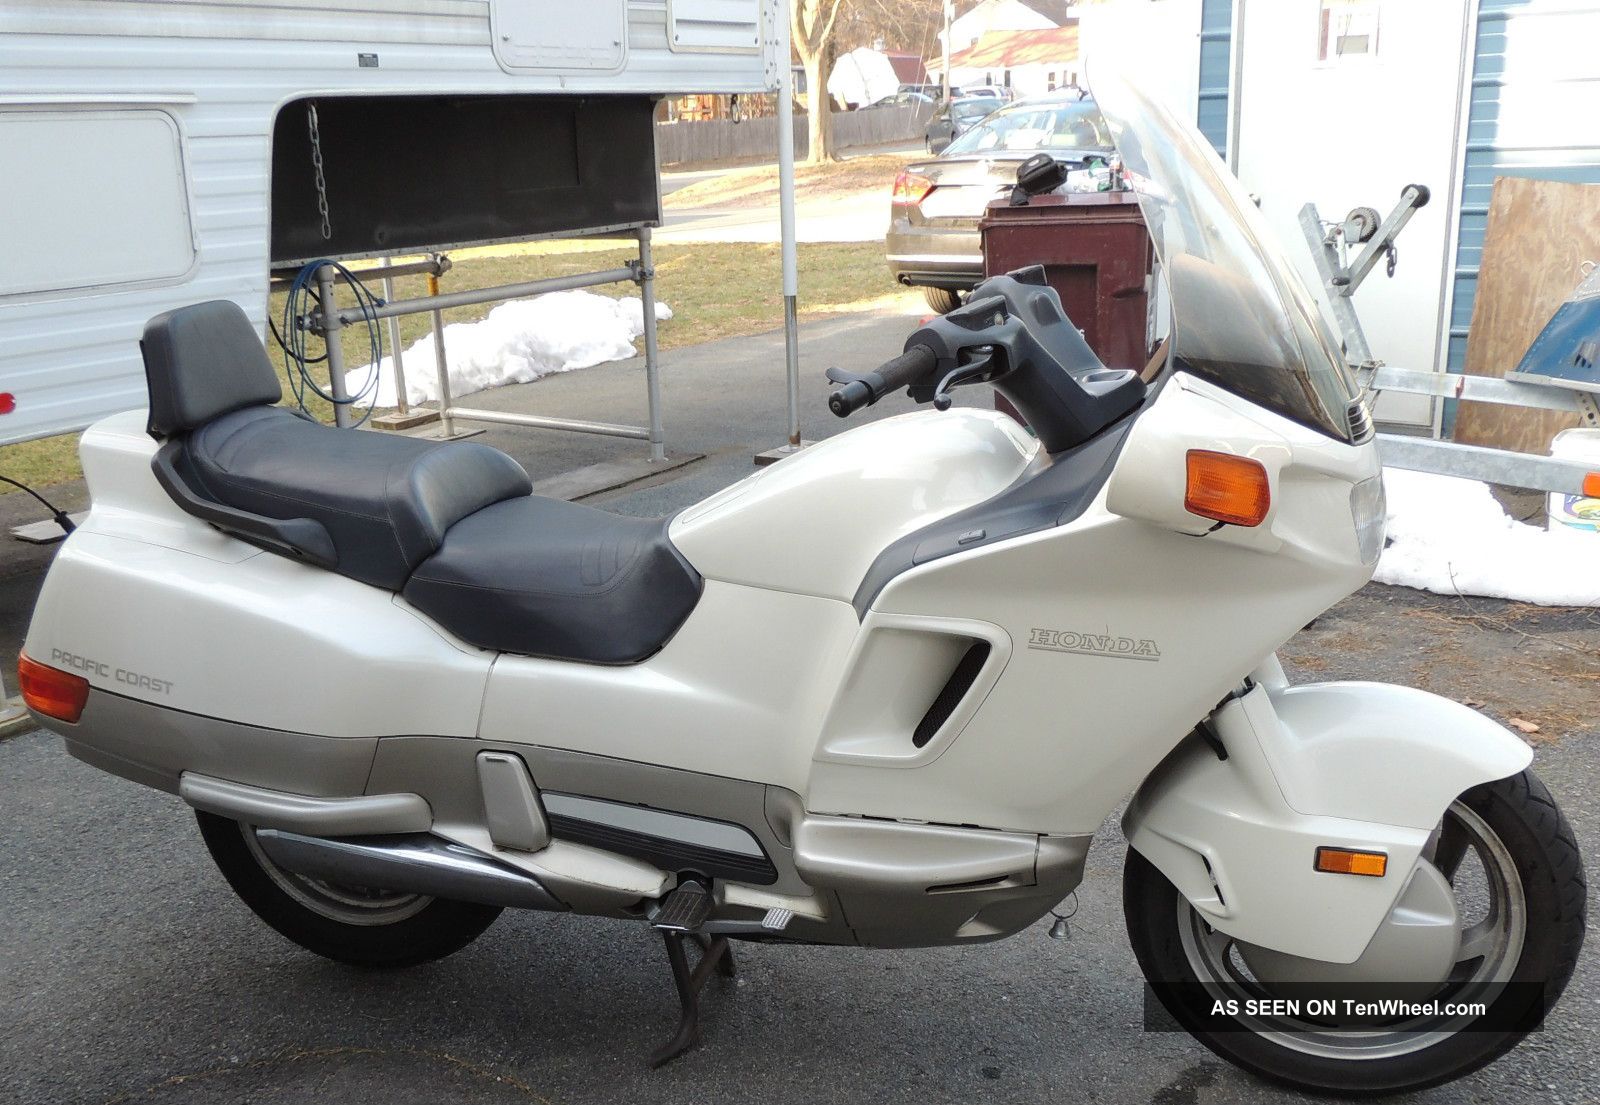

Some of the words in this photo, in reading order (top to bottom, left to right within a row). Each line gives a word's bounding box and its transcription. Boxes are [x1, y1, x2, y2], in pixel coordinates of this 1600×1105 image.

[1028, 627, 1161, 657] HONDA
[52, 648, 109, 678] PACIFIC
[115, 668, 174, 694] COAST
